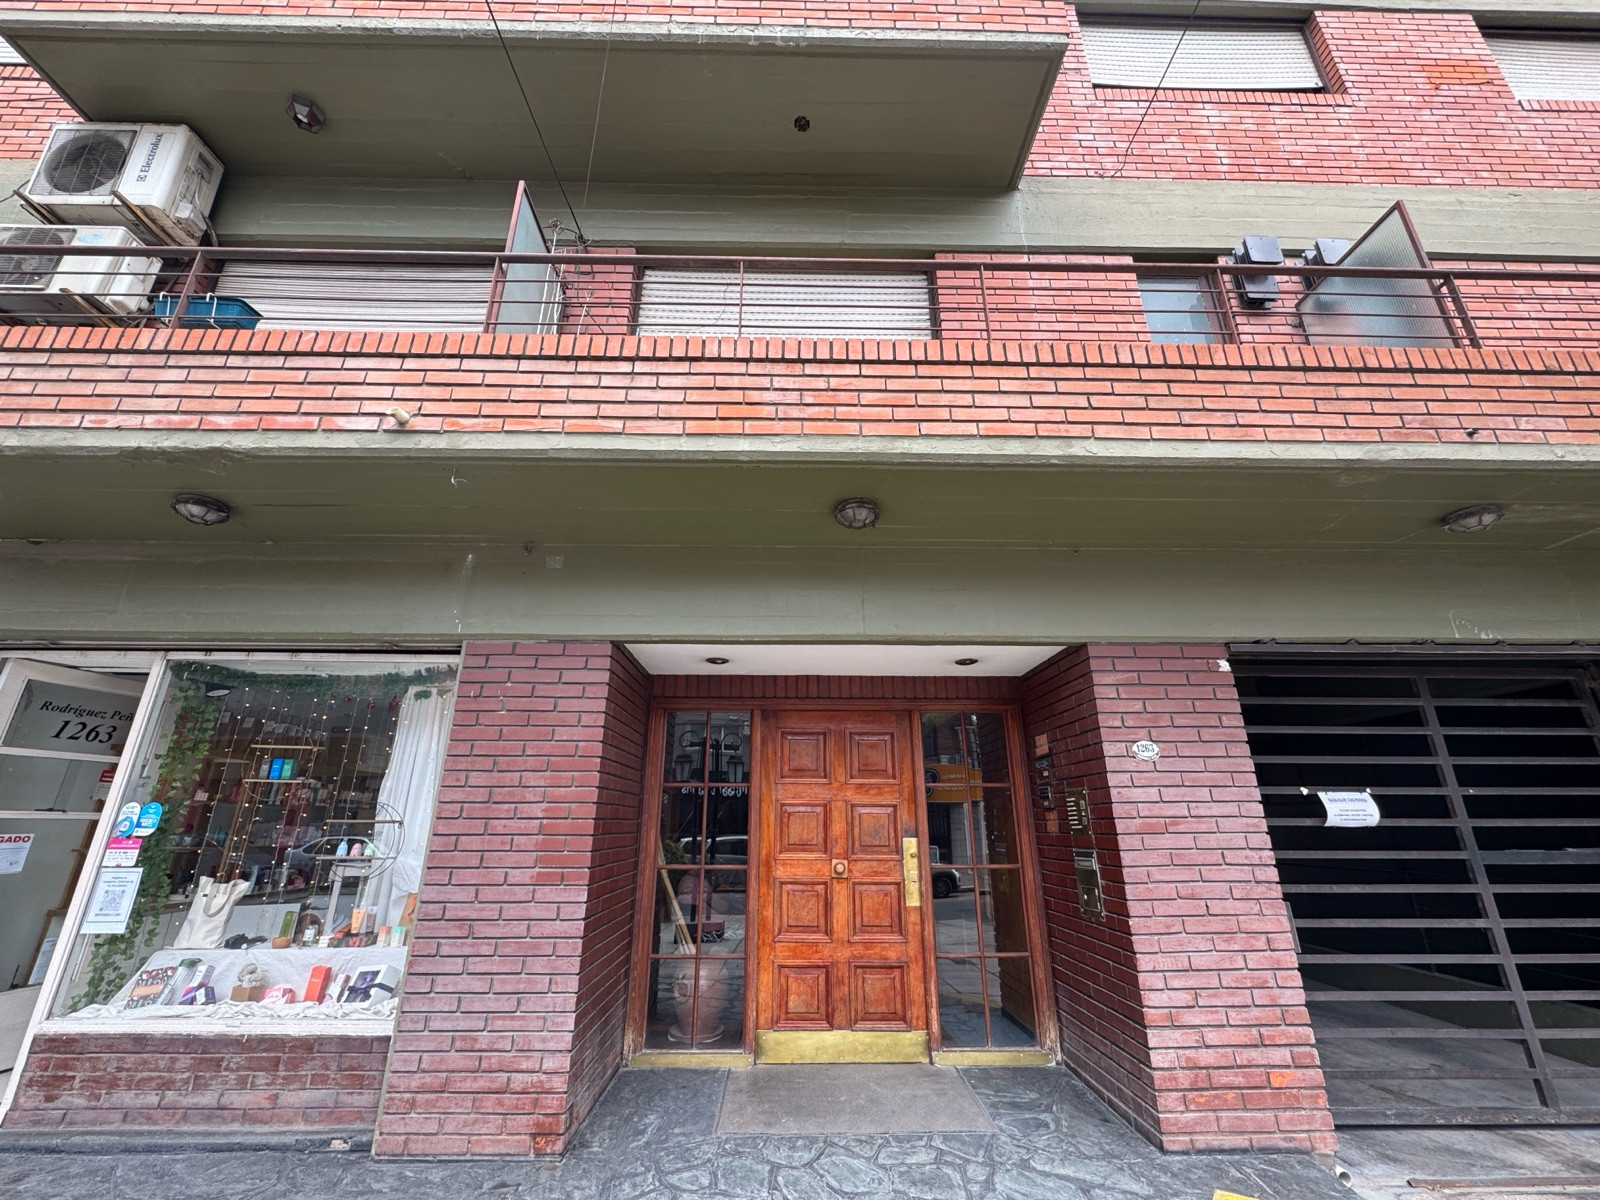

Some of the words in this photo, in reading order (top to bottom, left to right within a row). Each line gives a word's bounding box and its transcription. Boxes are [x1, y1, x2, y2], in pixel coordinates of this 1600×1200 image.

[140, 132, 164, 173] Electrolux
[110, 710, 135, 722] Peñ
[49, 720, 118, 744] 1263
[1136, 743, 1155, 753] 1263
